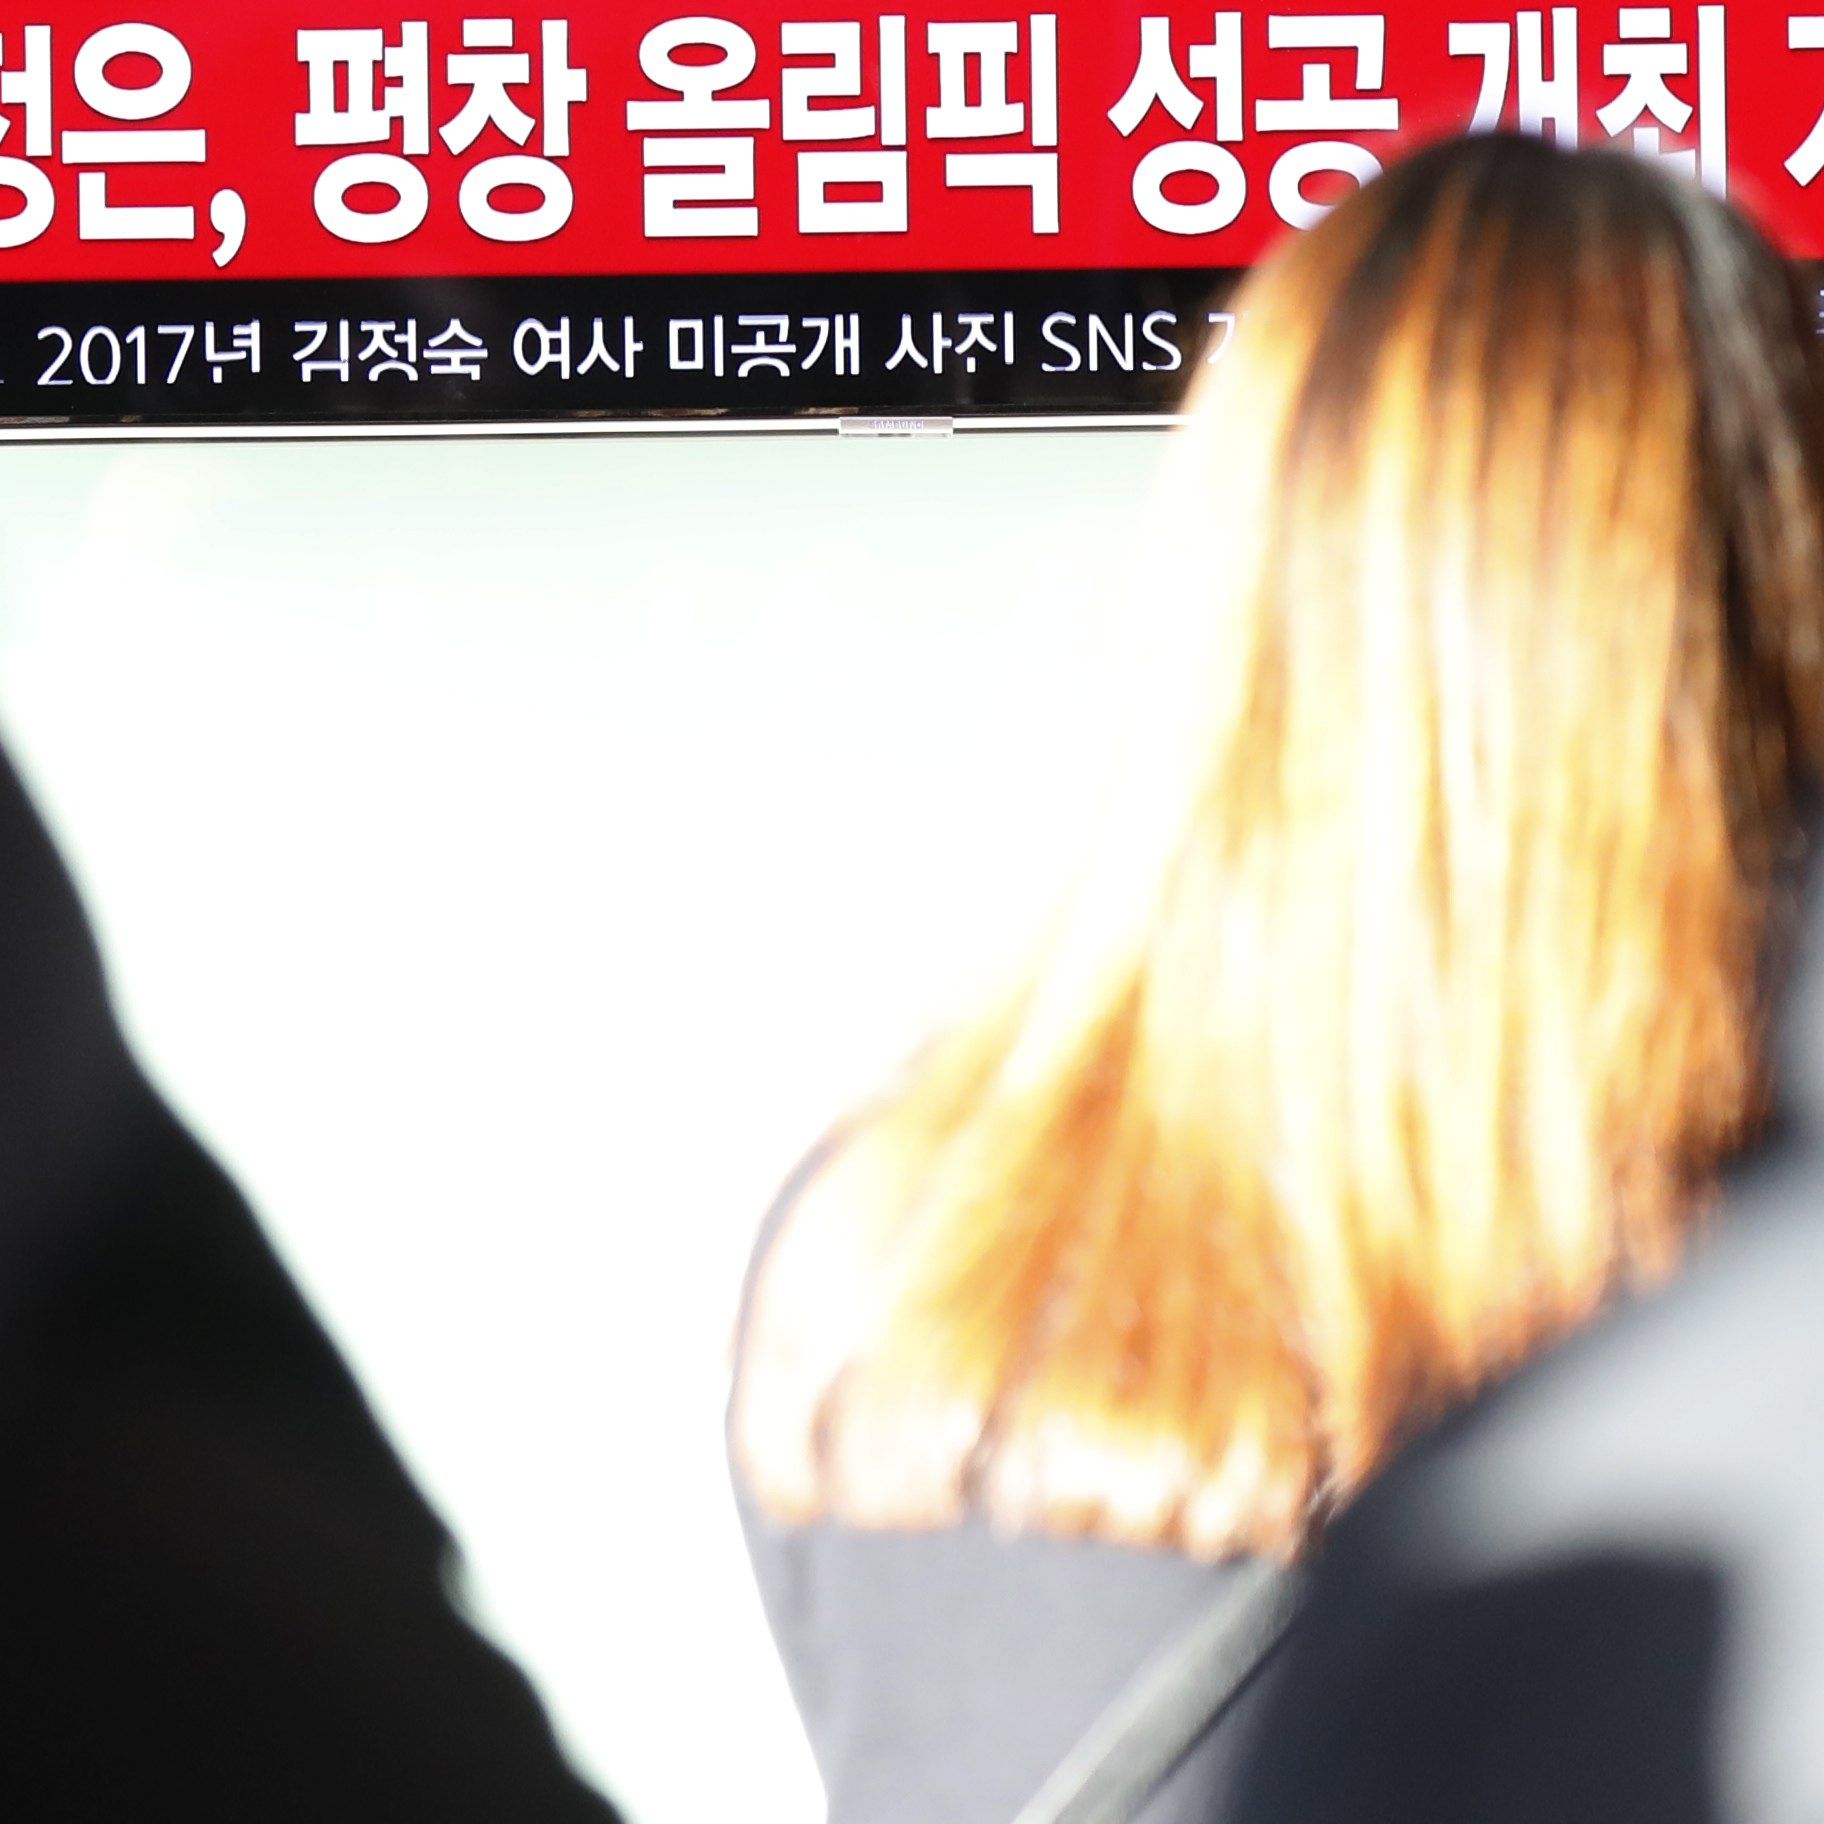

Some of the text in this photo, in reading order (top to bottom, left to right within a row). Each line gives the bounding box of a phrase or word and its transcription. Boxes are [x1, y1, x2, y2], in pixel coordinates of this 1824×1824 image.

[294, 18, 587, 243] 평창
[626, 13, 1060, 237] 올림픽
[1107, 11, 1399, 235] 성공
[37, 316, 261, 386] 2017년
[513, 316, 644, 380] 여사
[668, 313, 860, 378] 미공개
[884, 311, 1014, 374] 사진
[1041, 310, 1182, 372] SNS
